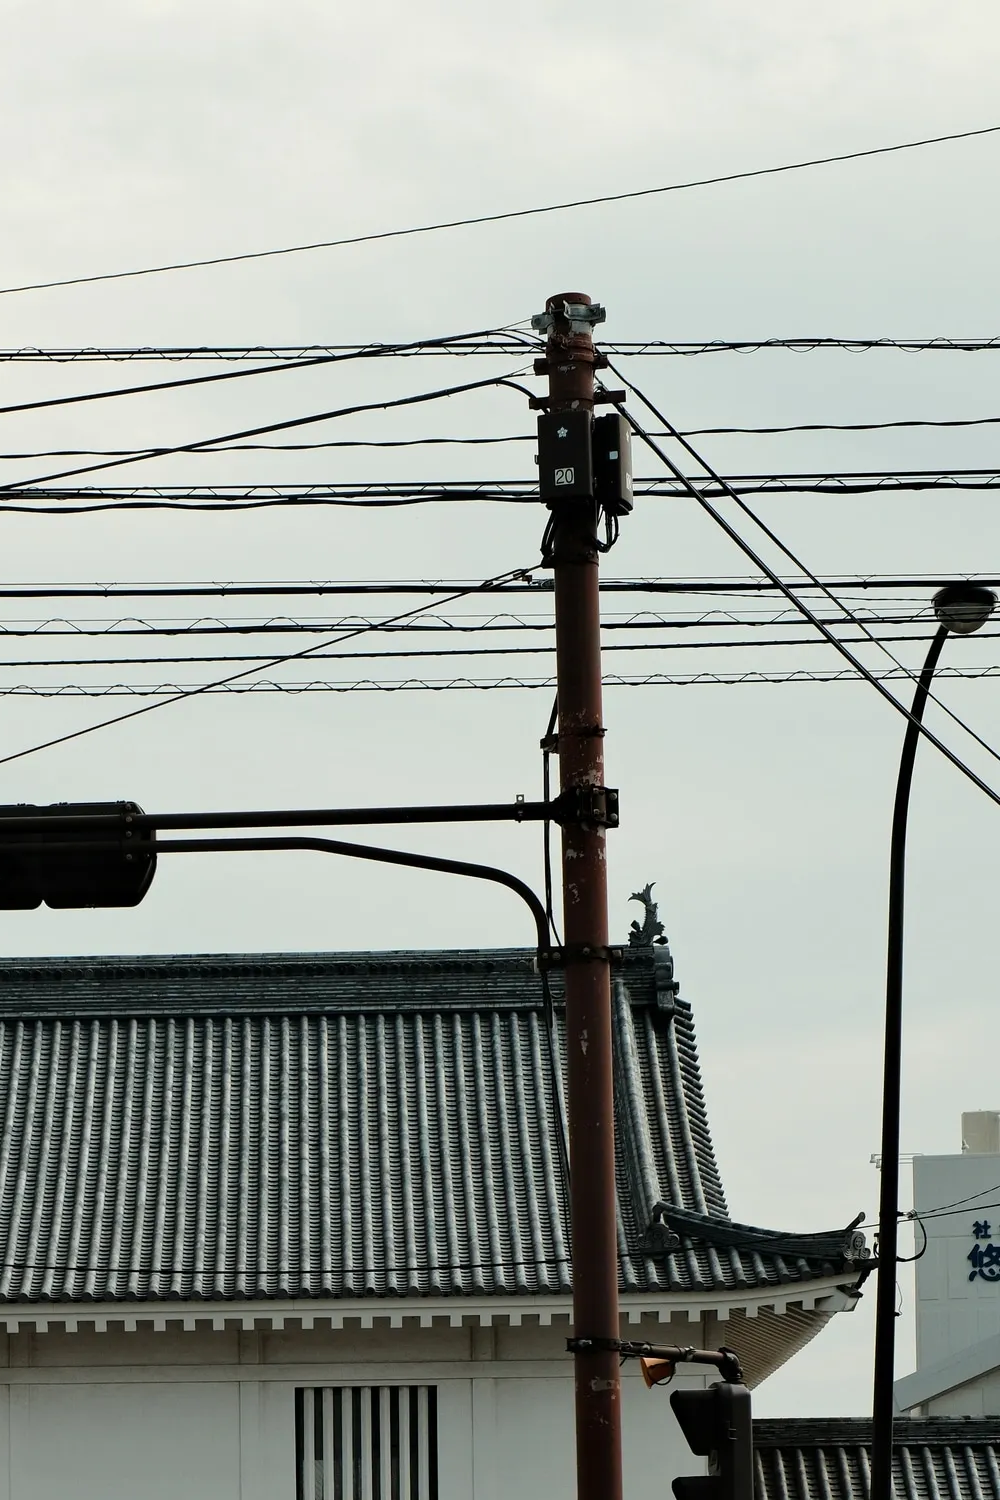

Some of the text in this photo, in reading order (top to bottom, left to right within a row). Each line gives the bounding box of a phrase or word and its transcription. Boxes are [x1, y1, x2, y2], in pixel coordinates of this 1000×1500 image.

[556, 469, 573, 484] 20
[972, 1219, 1000, 1240] 社
[967, 1243, 1000, 1282] 悠
